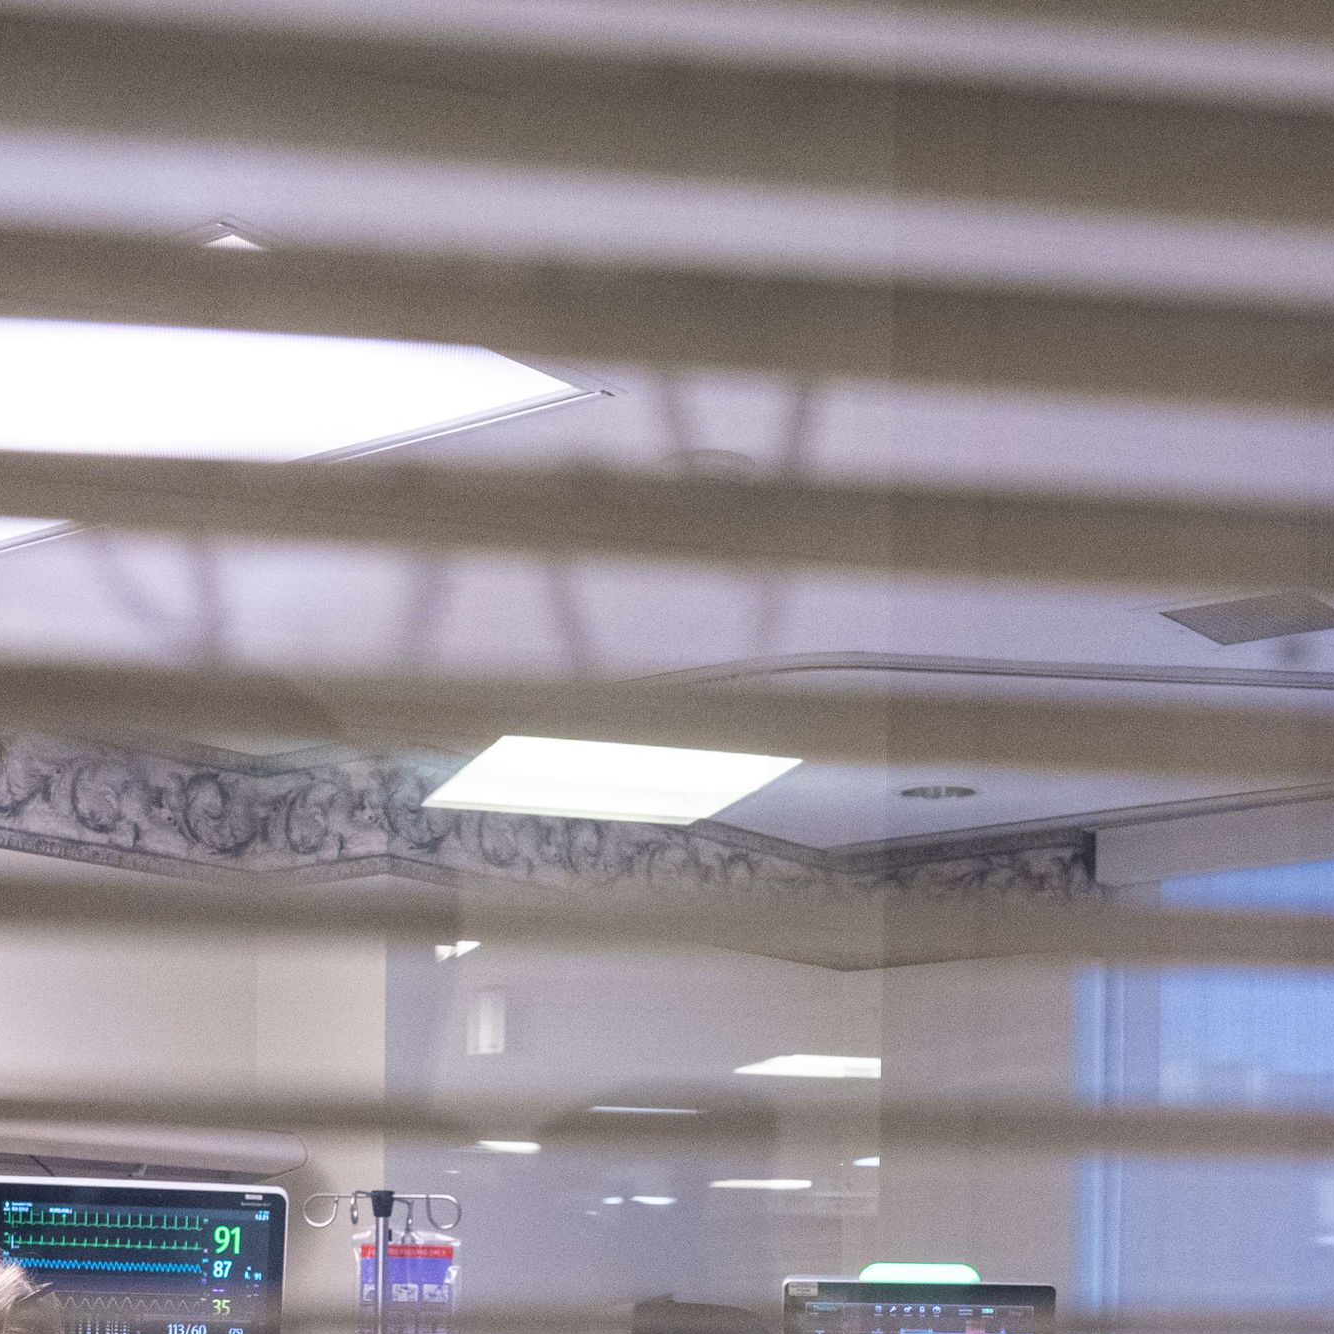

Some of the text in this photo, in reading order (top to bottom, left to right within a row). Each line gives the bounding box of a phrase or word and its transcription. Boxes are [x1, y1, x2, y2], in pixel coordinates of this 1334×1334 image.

[214, 1225, 241, 1255] 91
[213, 1260, 232, 1278] 87
[212, 1299, 231, 1316] 35
